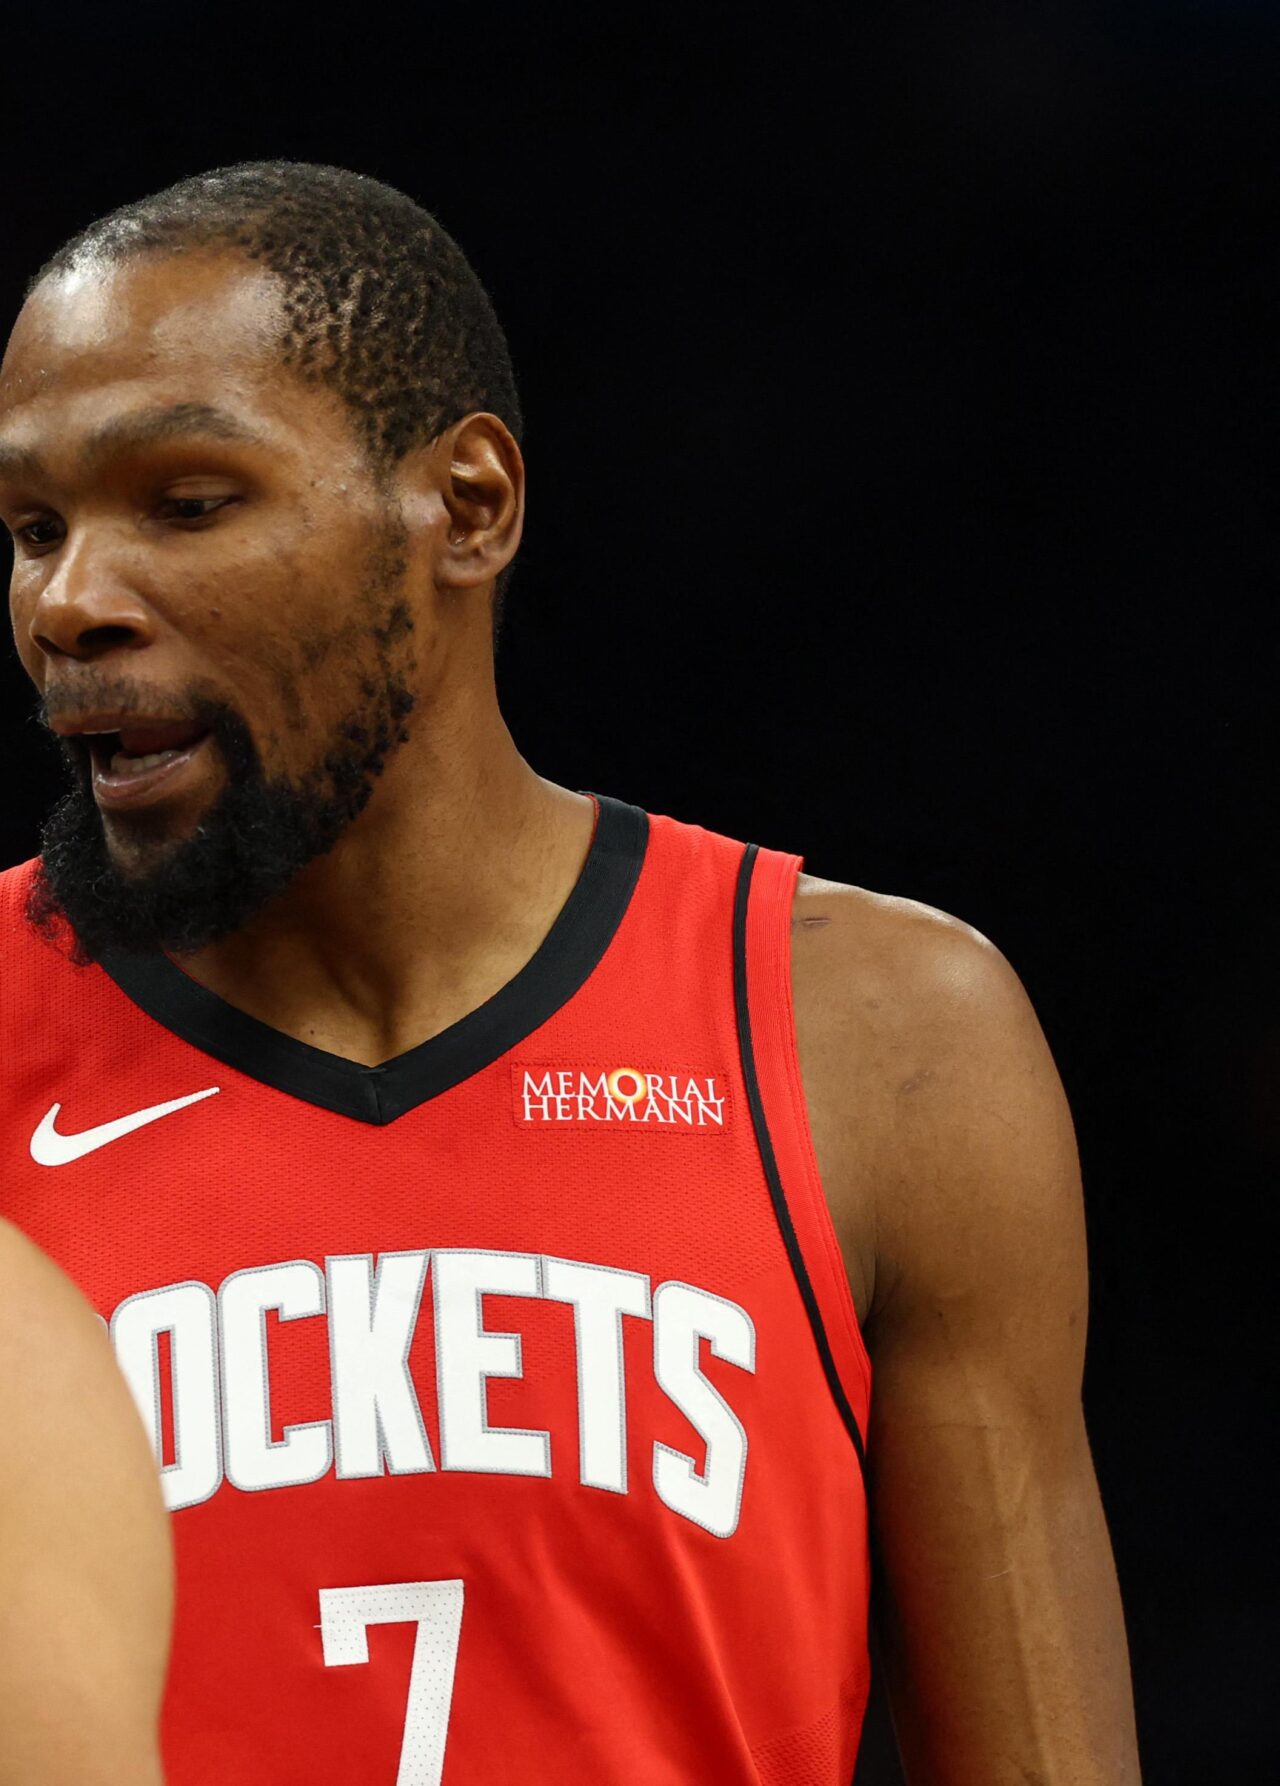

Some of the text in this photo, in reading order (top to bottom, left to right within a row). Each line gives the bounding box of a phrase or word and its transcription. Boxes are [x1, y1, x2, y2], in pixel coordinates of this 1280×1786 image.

[521, 1069, 725, 1102] MEMORIAL
[523, 1095, 724, 1126] HERMANN
[96, 1247, 757, 1540] OCKETS
[318, 1578, 465, 1786] 7
